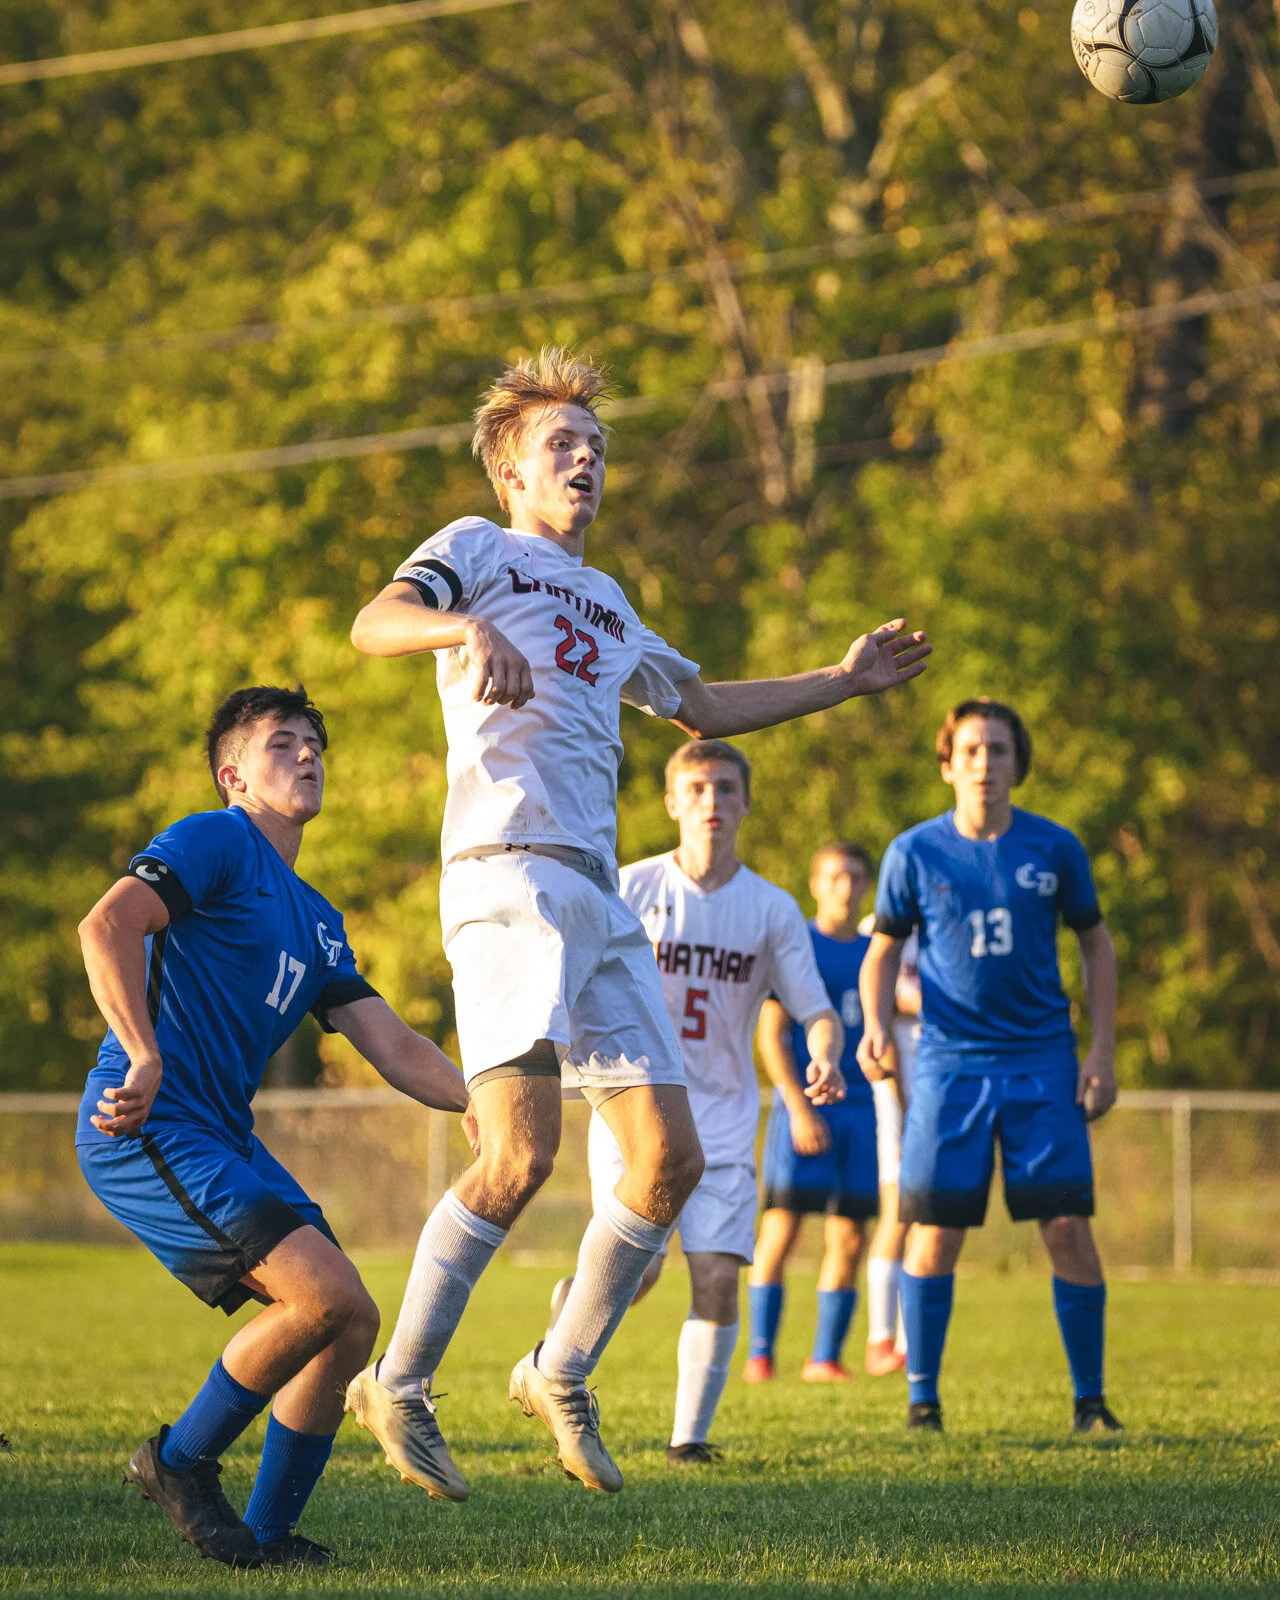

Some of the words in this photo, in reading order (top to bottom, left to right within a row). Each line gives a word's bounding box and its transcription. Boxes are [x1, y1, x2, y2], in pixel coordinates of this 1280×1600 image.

[404, 568, 437, 583] TAIN
[554, 614, 600, 687] 22
[970, 907, 1014, 958] 13
[265, 950, 307, 1016] 17
[656, 941, 756, 984] HATHAM
[681, 987, 708, 1041] 5
